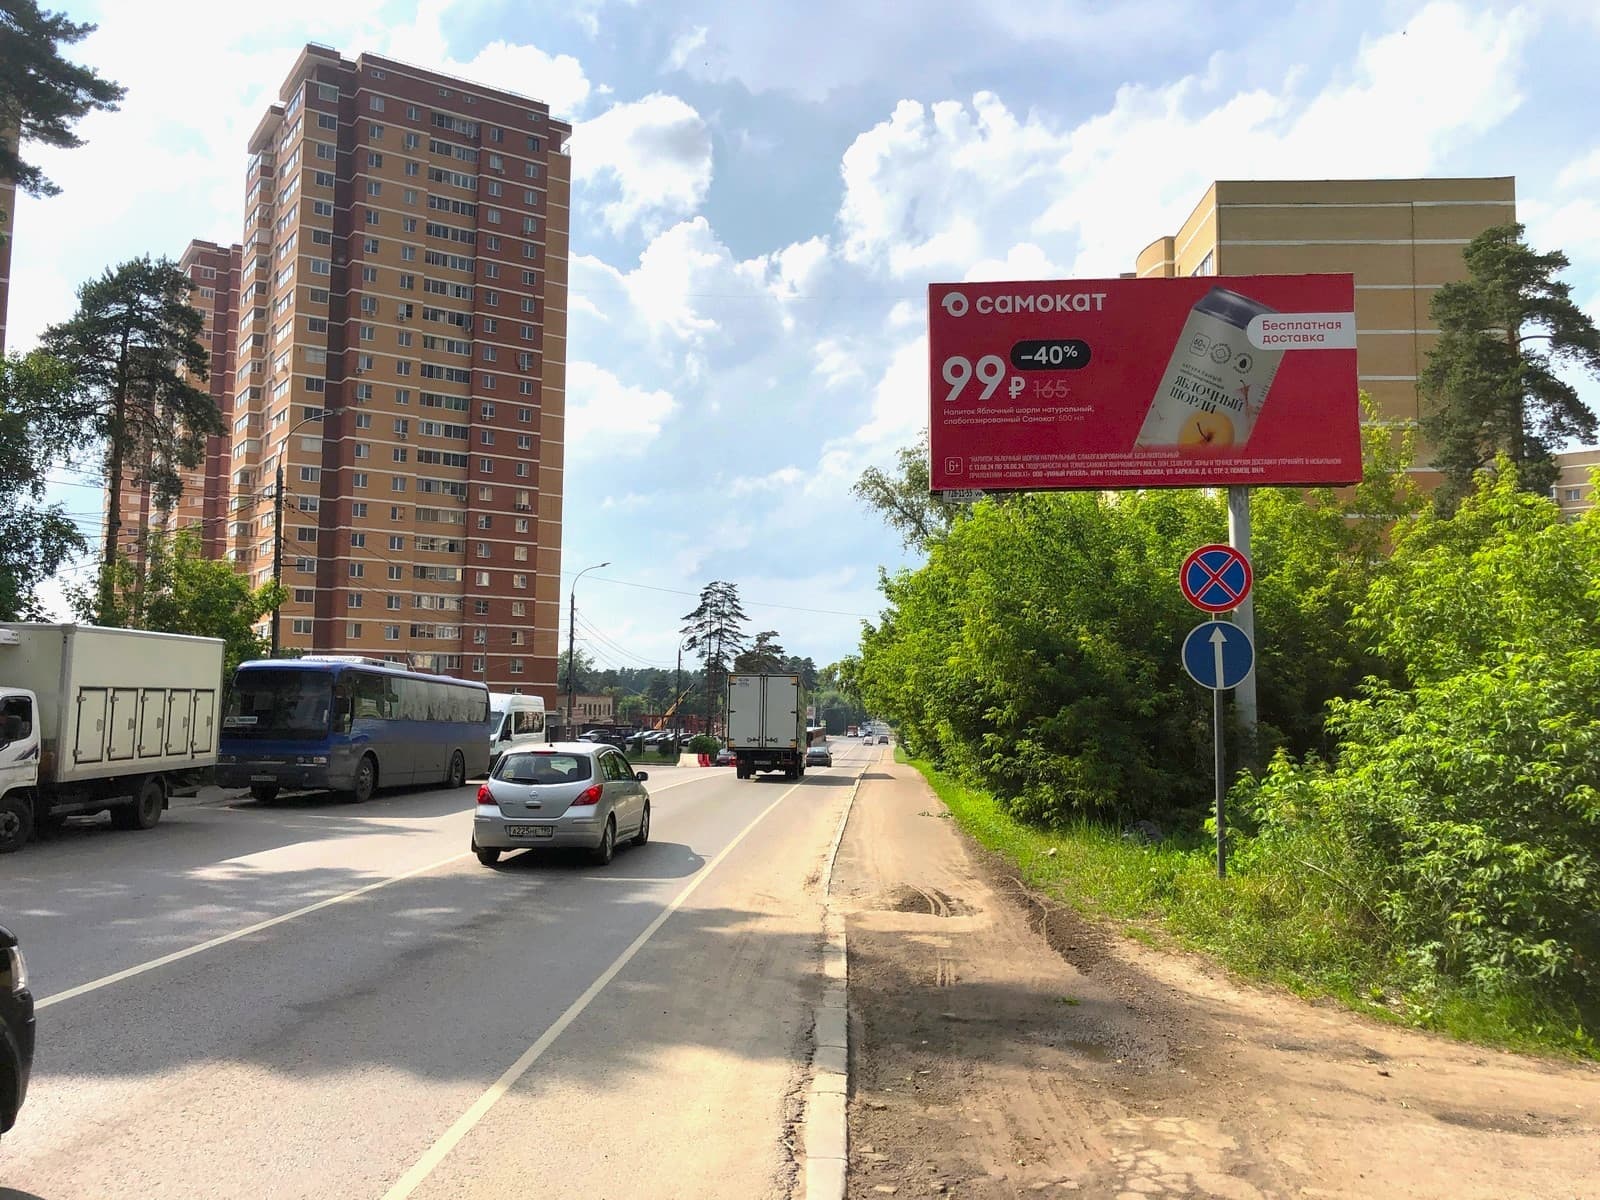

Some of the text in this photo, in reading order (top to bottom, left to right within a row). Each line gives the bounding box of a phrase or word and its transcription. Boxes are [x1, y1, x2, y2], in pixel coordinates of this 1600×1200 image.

[976, 293, 1107, 314] самокат
[1262, 319, 1342, 331] Бесплатная
[1262, 334, 1325, 344] доставка
[1021, 345, 1078, 365] -40%
[1033, 379, 1070, 399] 165
[1174, 375, 1244, 412] ЯБЛОЧНЫЙ
[1170, 386, 1217, 414] ШОРЛИ
[943, 405, 1095, 416] Напиток Яблочный шорли натуральный,
[943, 416, 1021, 425] слабогазированный
[1022, 415, 1055, 423] Самокат
[948, 460, 960, 472] 6+
